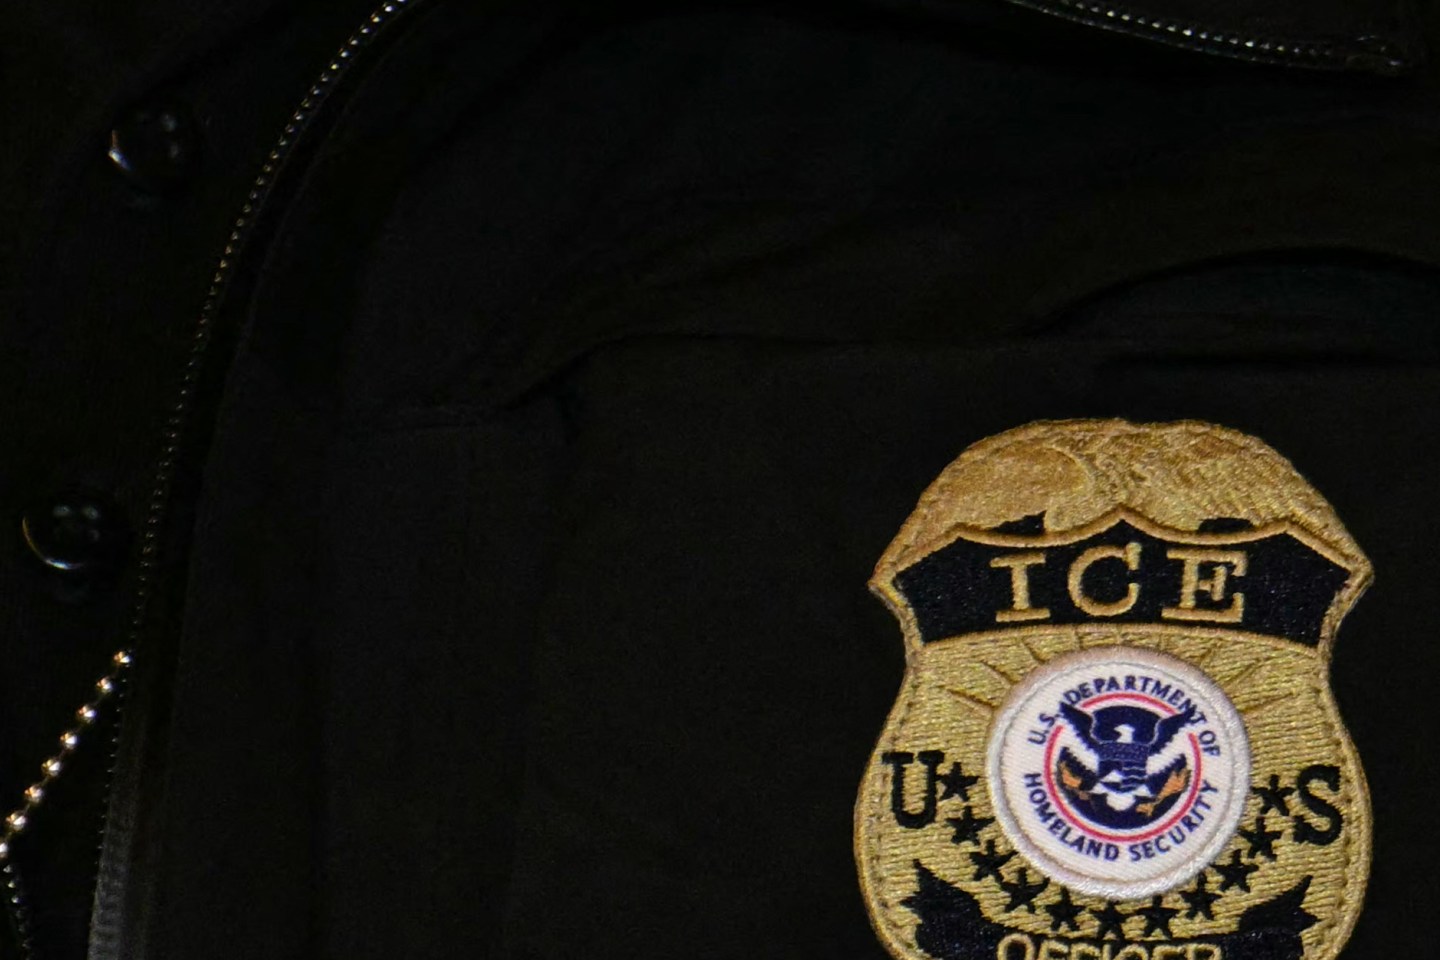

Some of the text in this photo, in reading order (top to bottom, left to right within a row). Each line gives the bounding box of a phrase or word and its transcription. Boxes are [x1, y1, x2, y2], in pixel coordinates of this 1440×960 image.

[991, 542, 1247, 626] ICE
[1062, 675, 1207, 727] DEPARTMENT
[1199, 729, 1221, 758] OF
[882, 751, 1343, 845] U S
[1024, 772, 1218, 862] HOMELAND SECURITY
